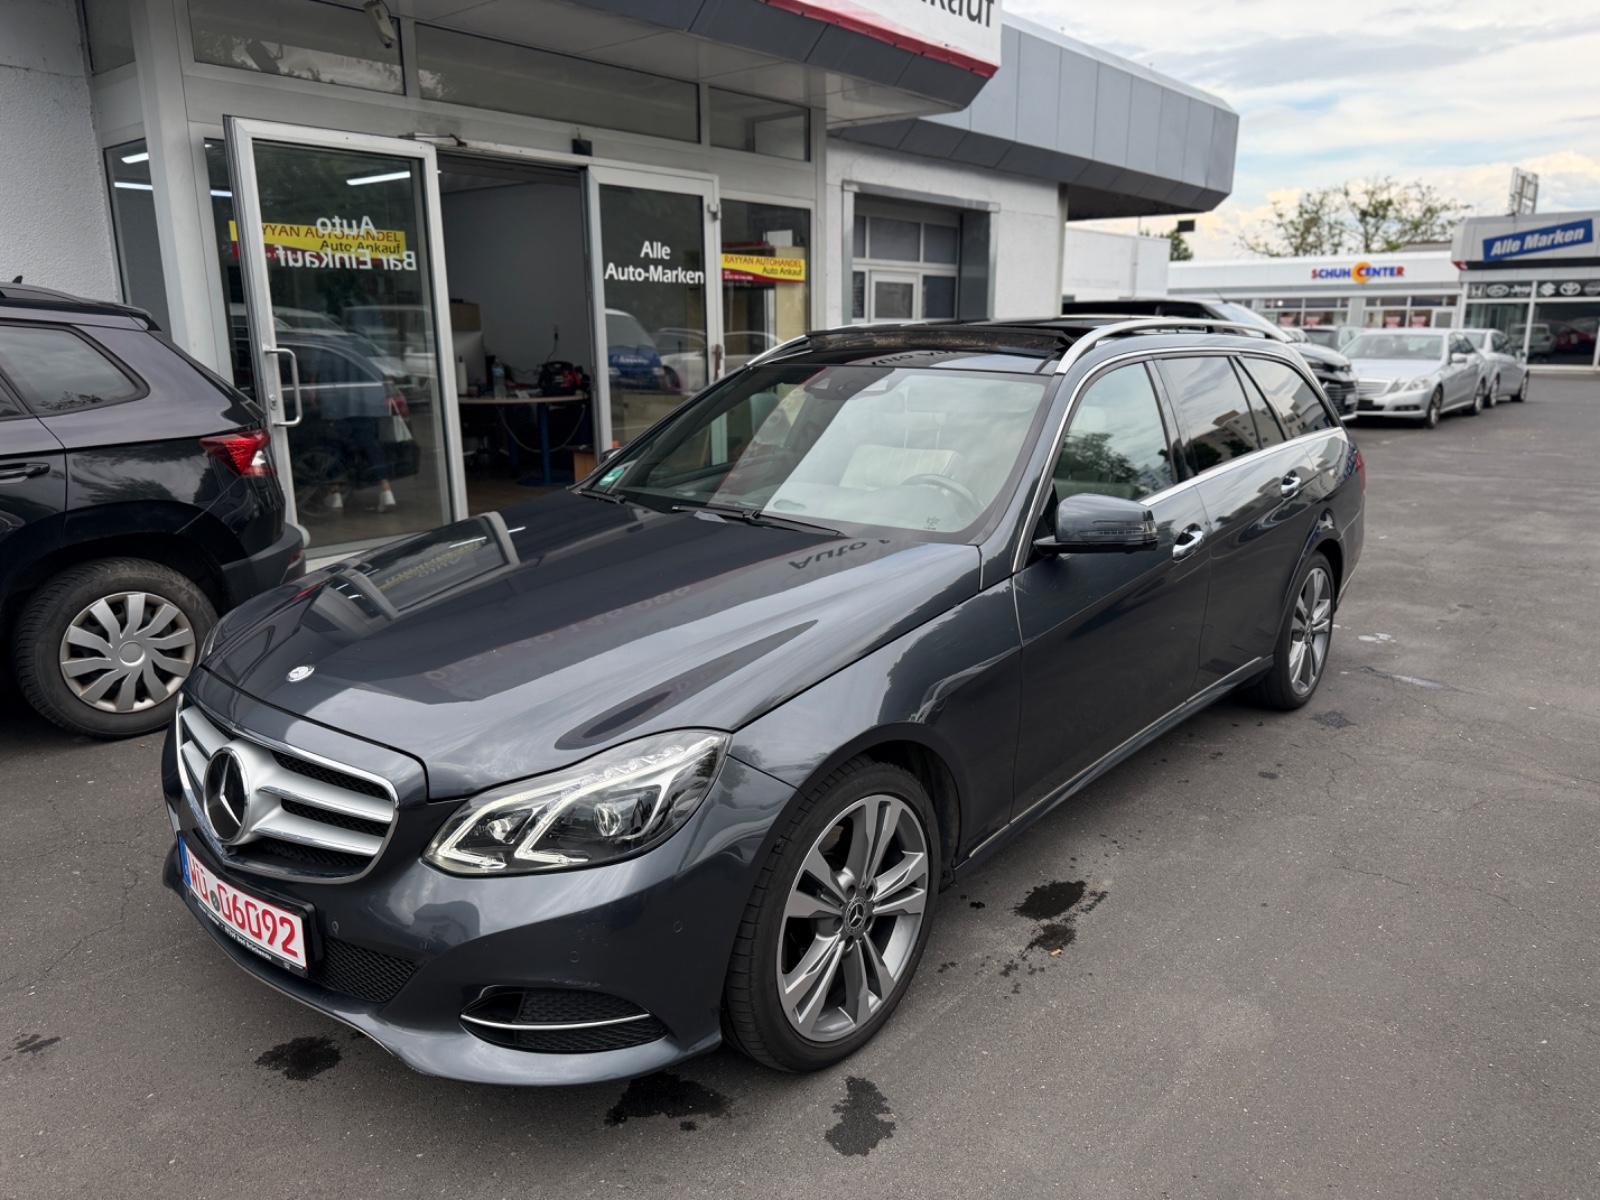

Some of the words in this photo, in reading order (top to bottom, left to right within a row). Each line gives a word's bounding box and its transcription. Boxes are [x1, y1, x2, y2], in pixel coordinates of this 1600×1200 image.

[639, 240, 671, 260] Alle
[1490, 238, 1521, 257] Alle
[1523, 227, 1585, 250] Marken
[604, 262, 705, 285] Auto-Marken
[1311, 267, 1351, 280] SCHUH
[1356, 265, 1405, 278] CENTER
[216, 882, 299, 959] 06092
